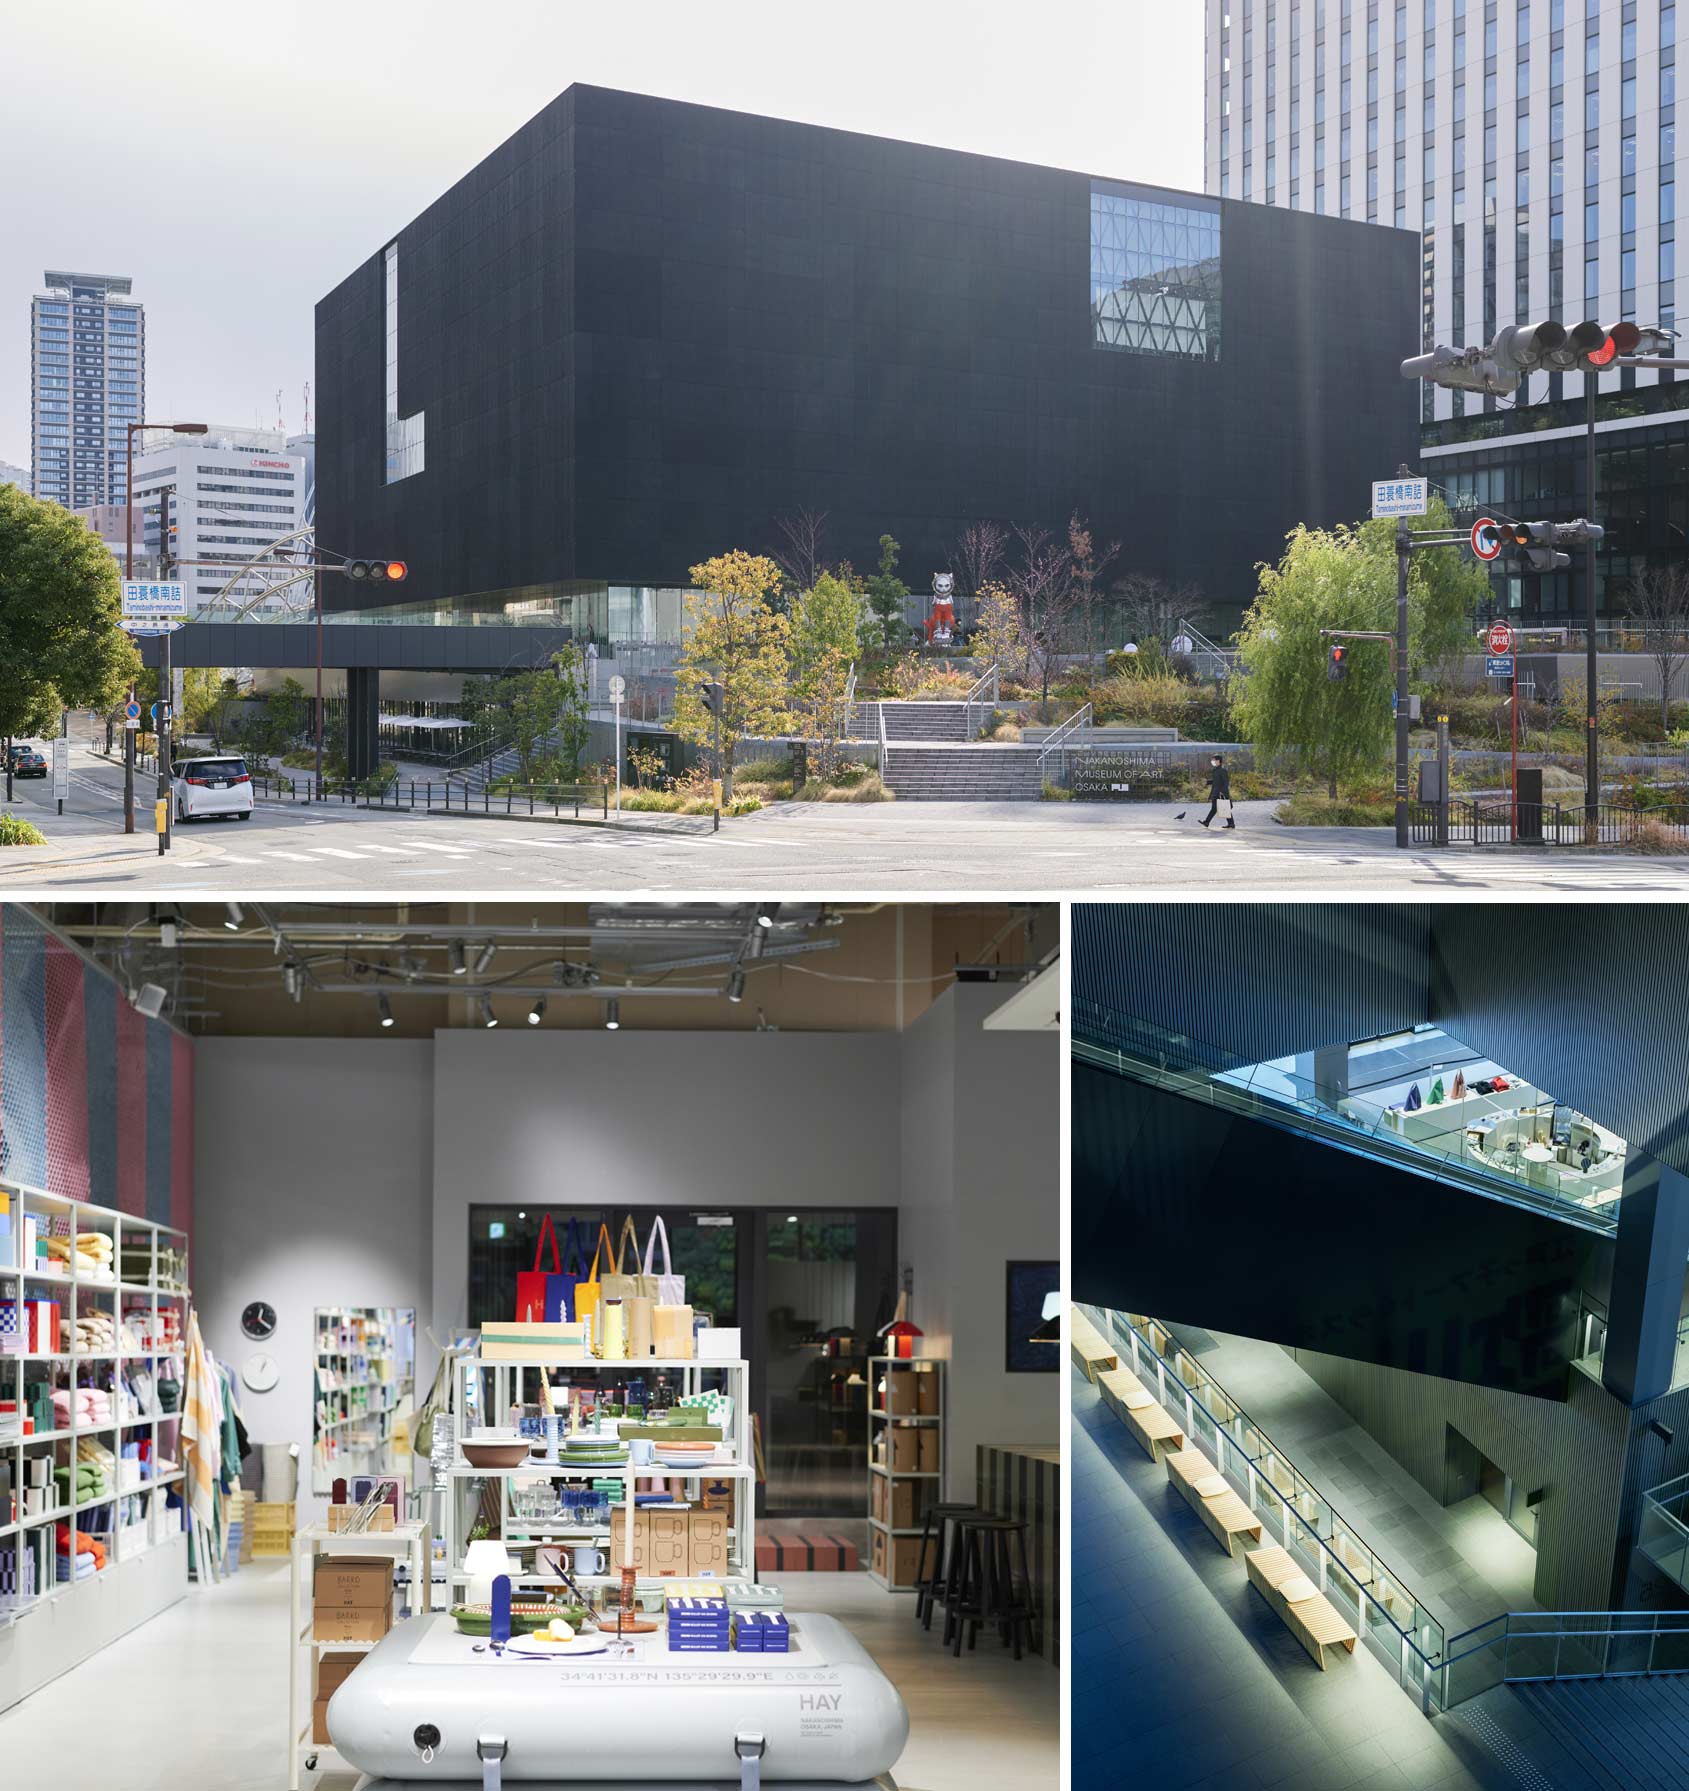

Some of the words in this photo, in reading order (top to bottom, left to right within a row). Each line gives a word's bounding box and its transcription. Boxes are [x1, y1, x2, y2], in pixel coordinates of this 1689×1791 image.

[127, 585, 181, 601] 田蓑橋南詰
[1075, 757, 1155, 766] NAKANOSHIMA
[1075, 770, 1121, 778] MUSEUM
[1124, 770, 1139, 778] OF
[1139, 770, 1165, 778] ART
[1075, 782, 1108, 791] OSAKA
[800, 1694, 842, 1710] HAY
